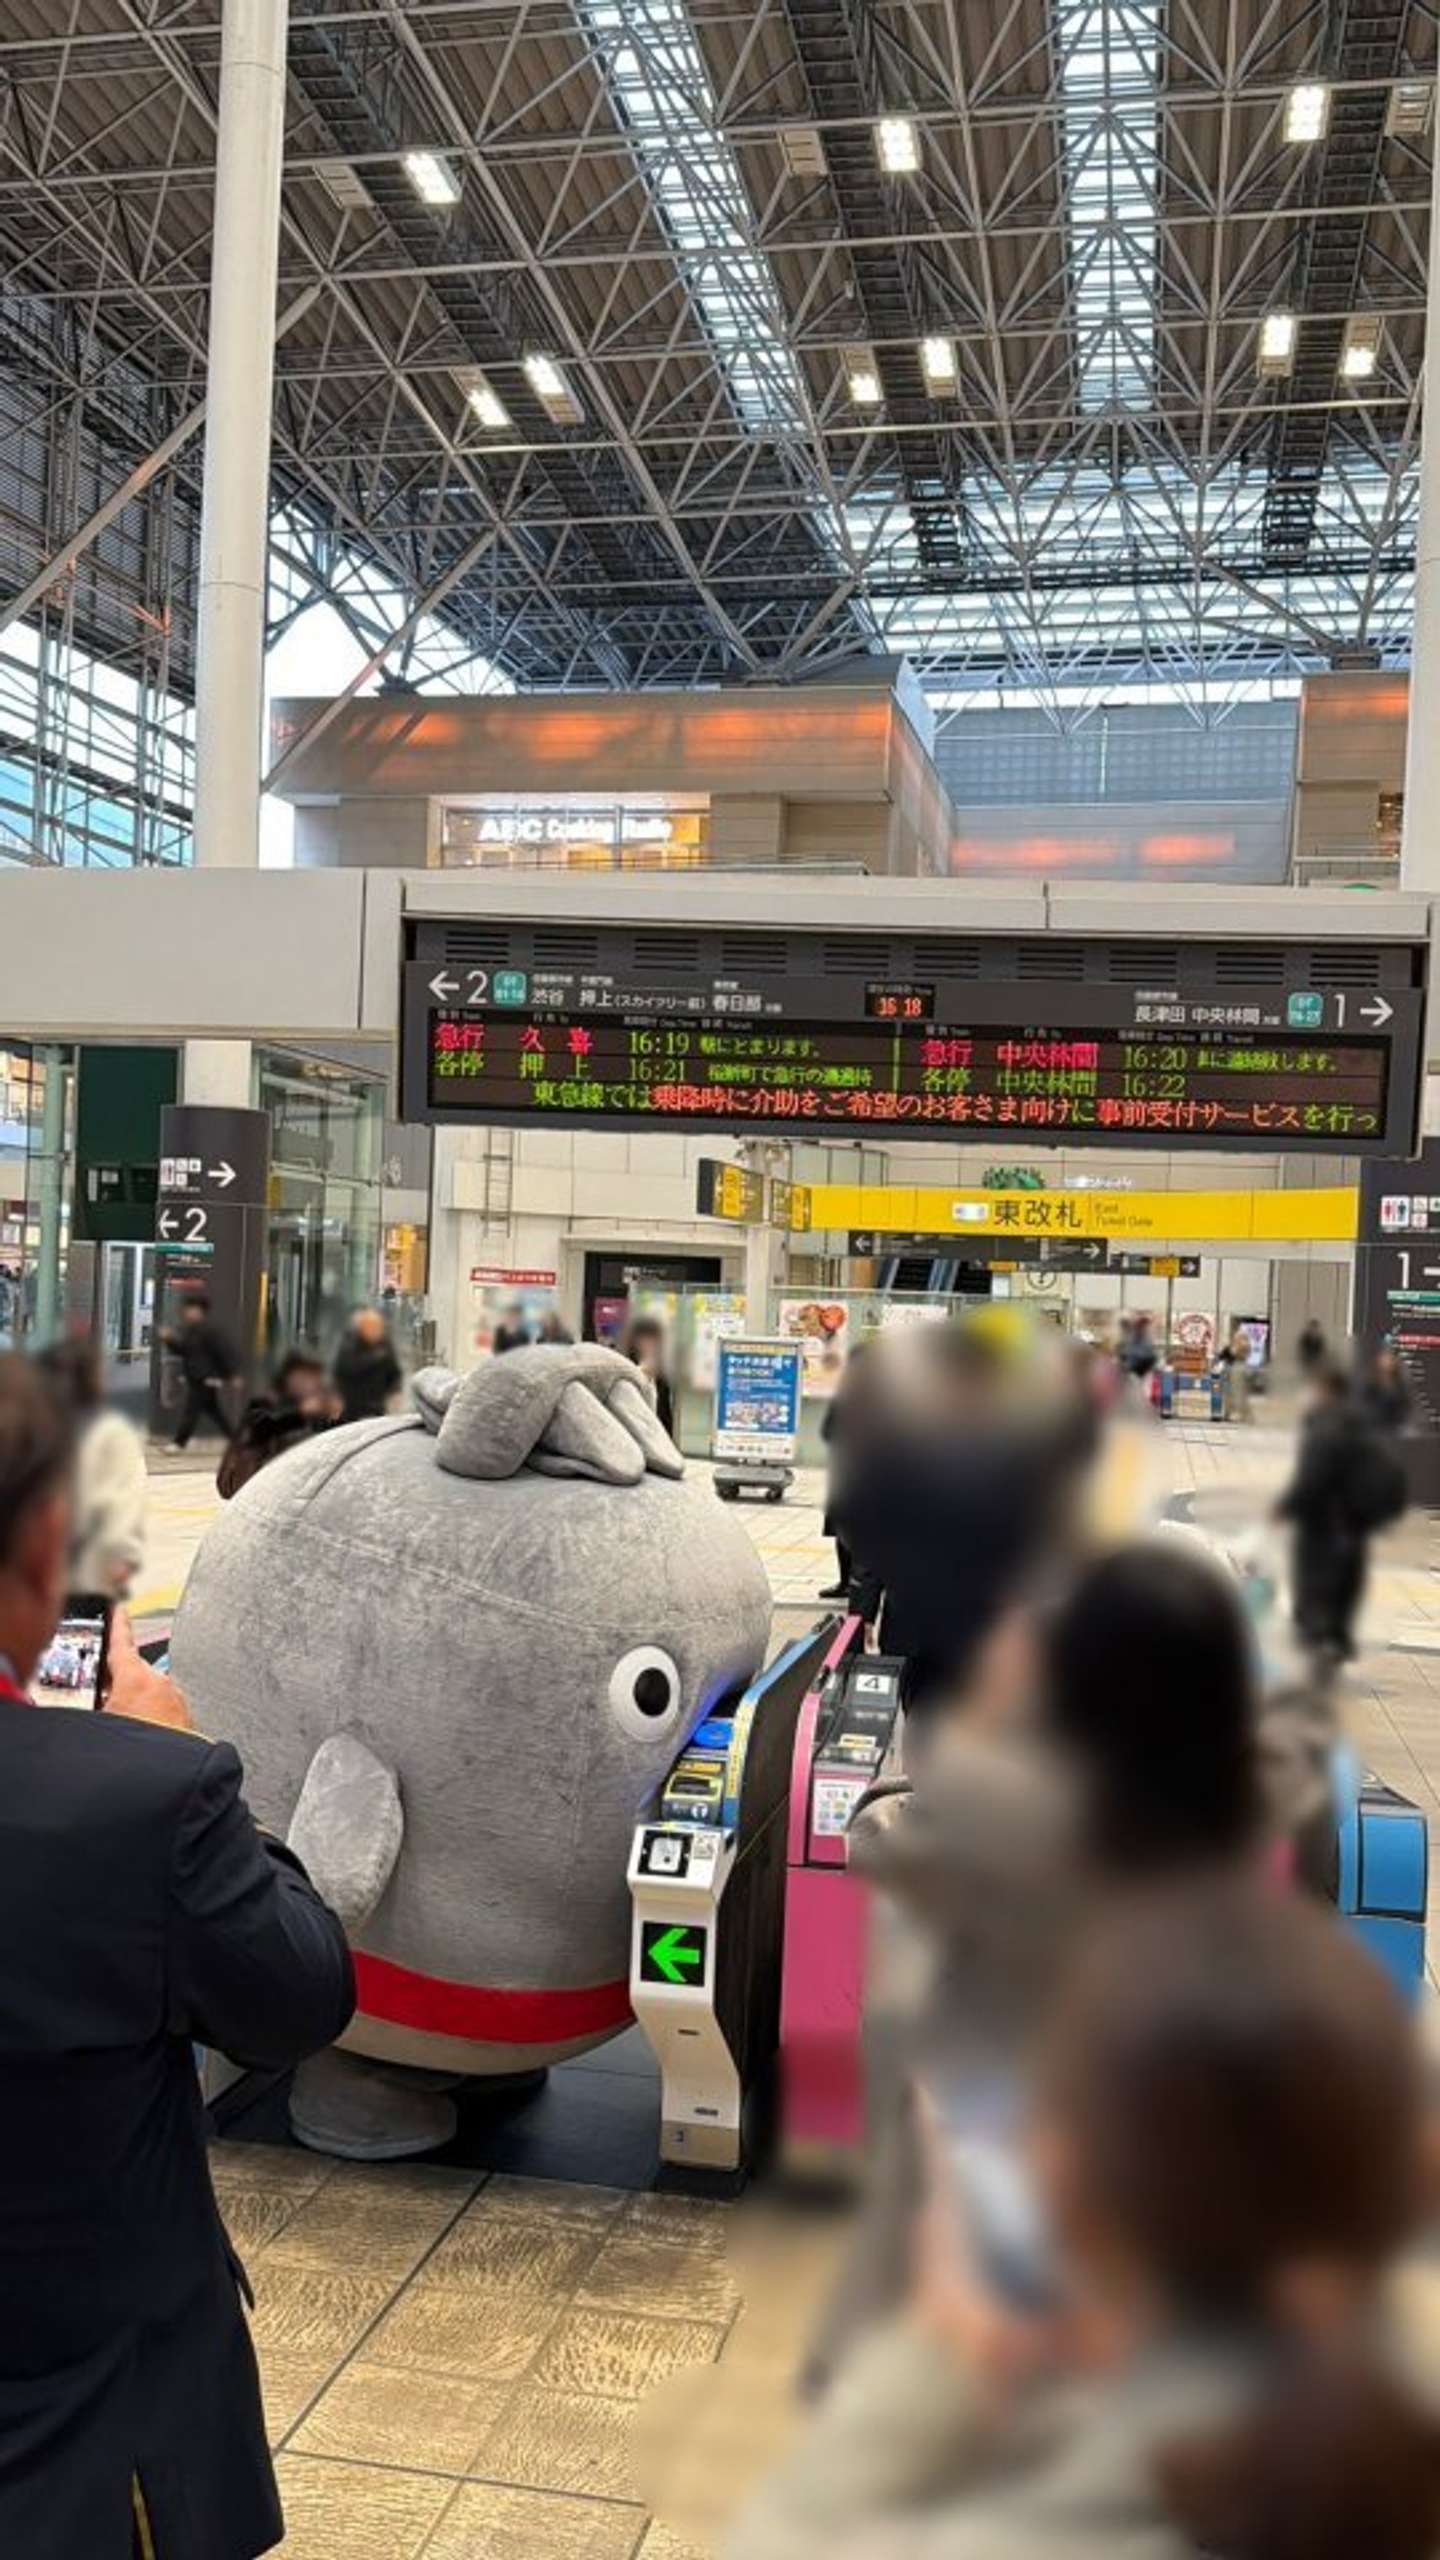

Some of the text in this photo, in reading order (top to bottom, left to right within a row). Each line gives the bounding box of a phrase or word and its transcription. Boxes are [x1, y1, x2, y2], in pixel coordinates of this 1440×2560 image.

[467, 970, 488, 1004] 2
[904, 998, 922, 1017] 18
[1134, 1004, 1186, 1023] 長津田
[1191, 1007, 1260, 1025] 中央林間
[1334, 994, 1346, 1028] 1
[435, 1023, 485, 1051] 急行
[630, 1031, 690, 1054] 16:19
[435, 1051, 485, 1076] 各停
[629, 1058, 686, 1081] 16:21
[921, 1039, 972, 1066] 急行
[997, 1040, 1100, 1069] 中央林間
[1124, 1046, 1188, 1070] 16:20
[921, 1066, 1186, 1098] 各停 中央林間 16:22
[184, 1208, 207, 1241] 2
[994, 1199, 1082, 1228] 東改札
[1398, 1252, 1410, 1289] 1
[864, 1676, 880, 1690] 4
